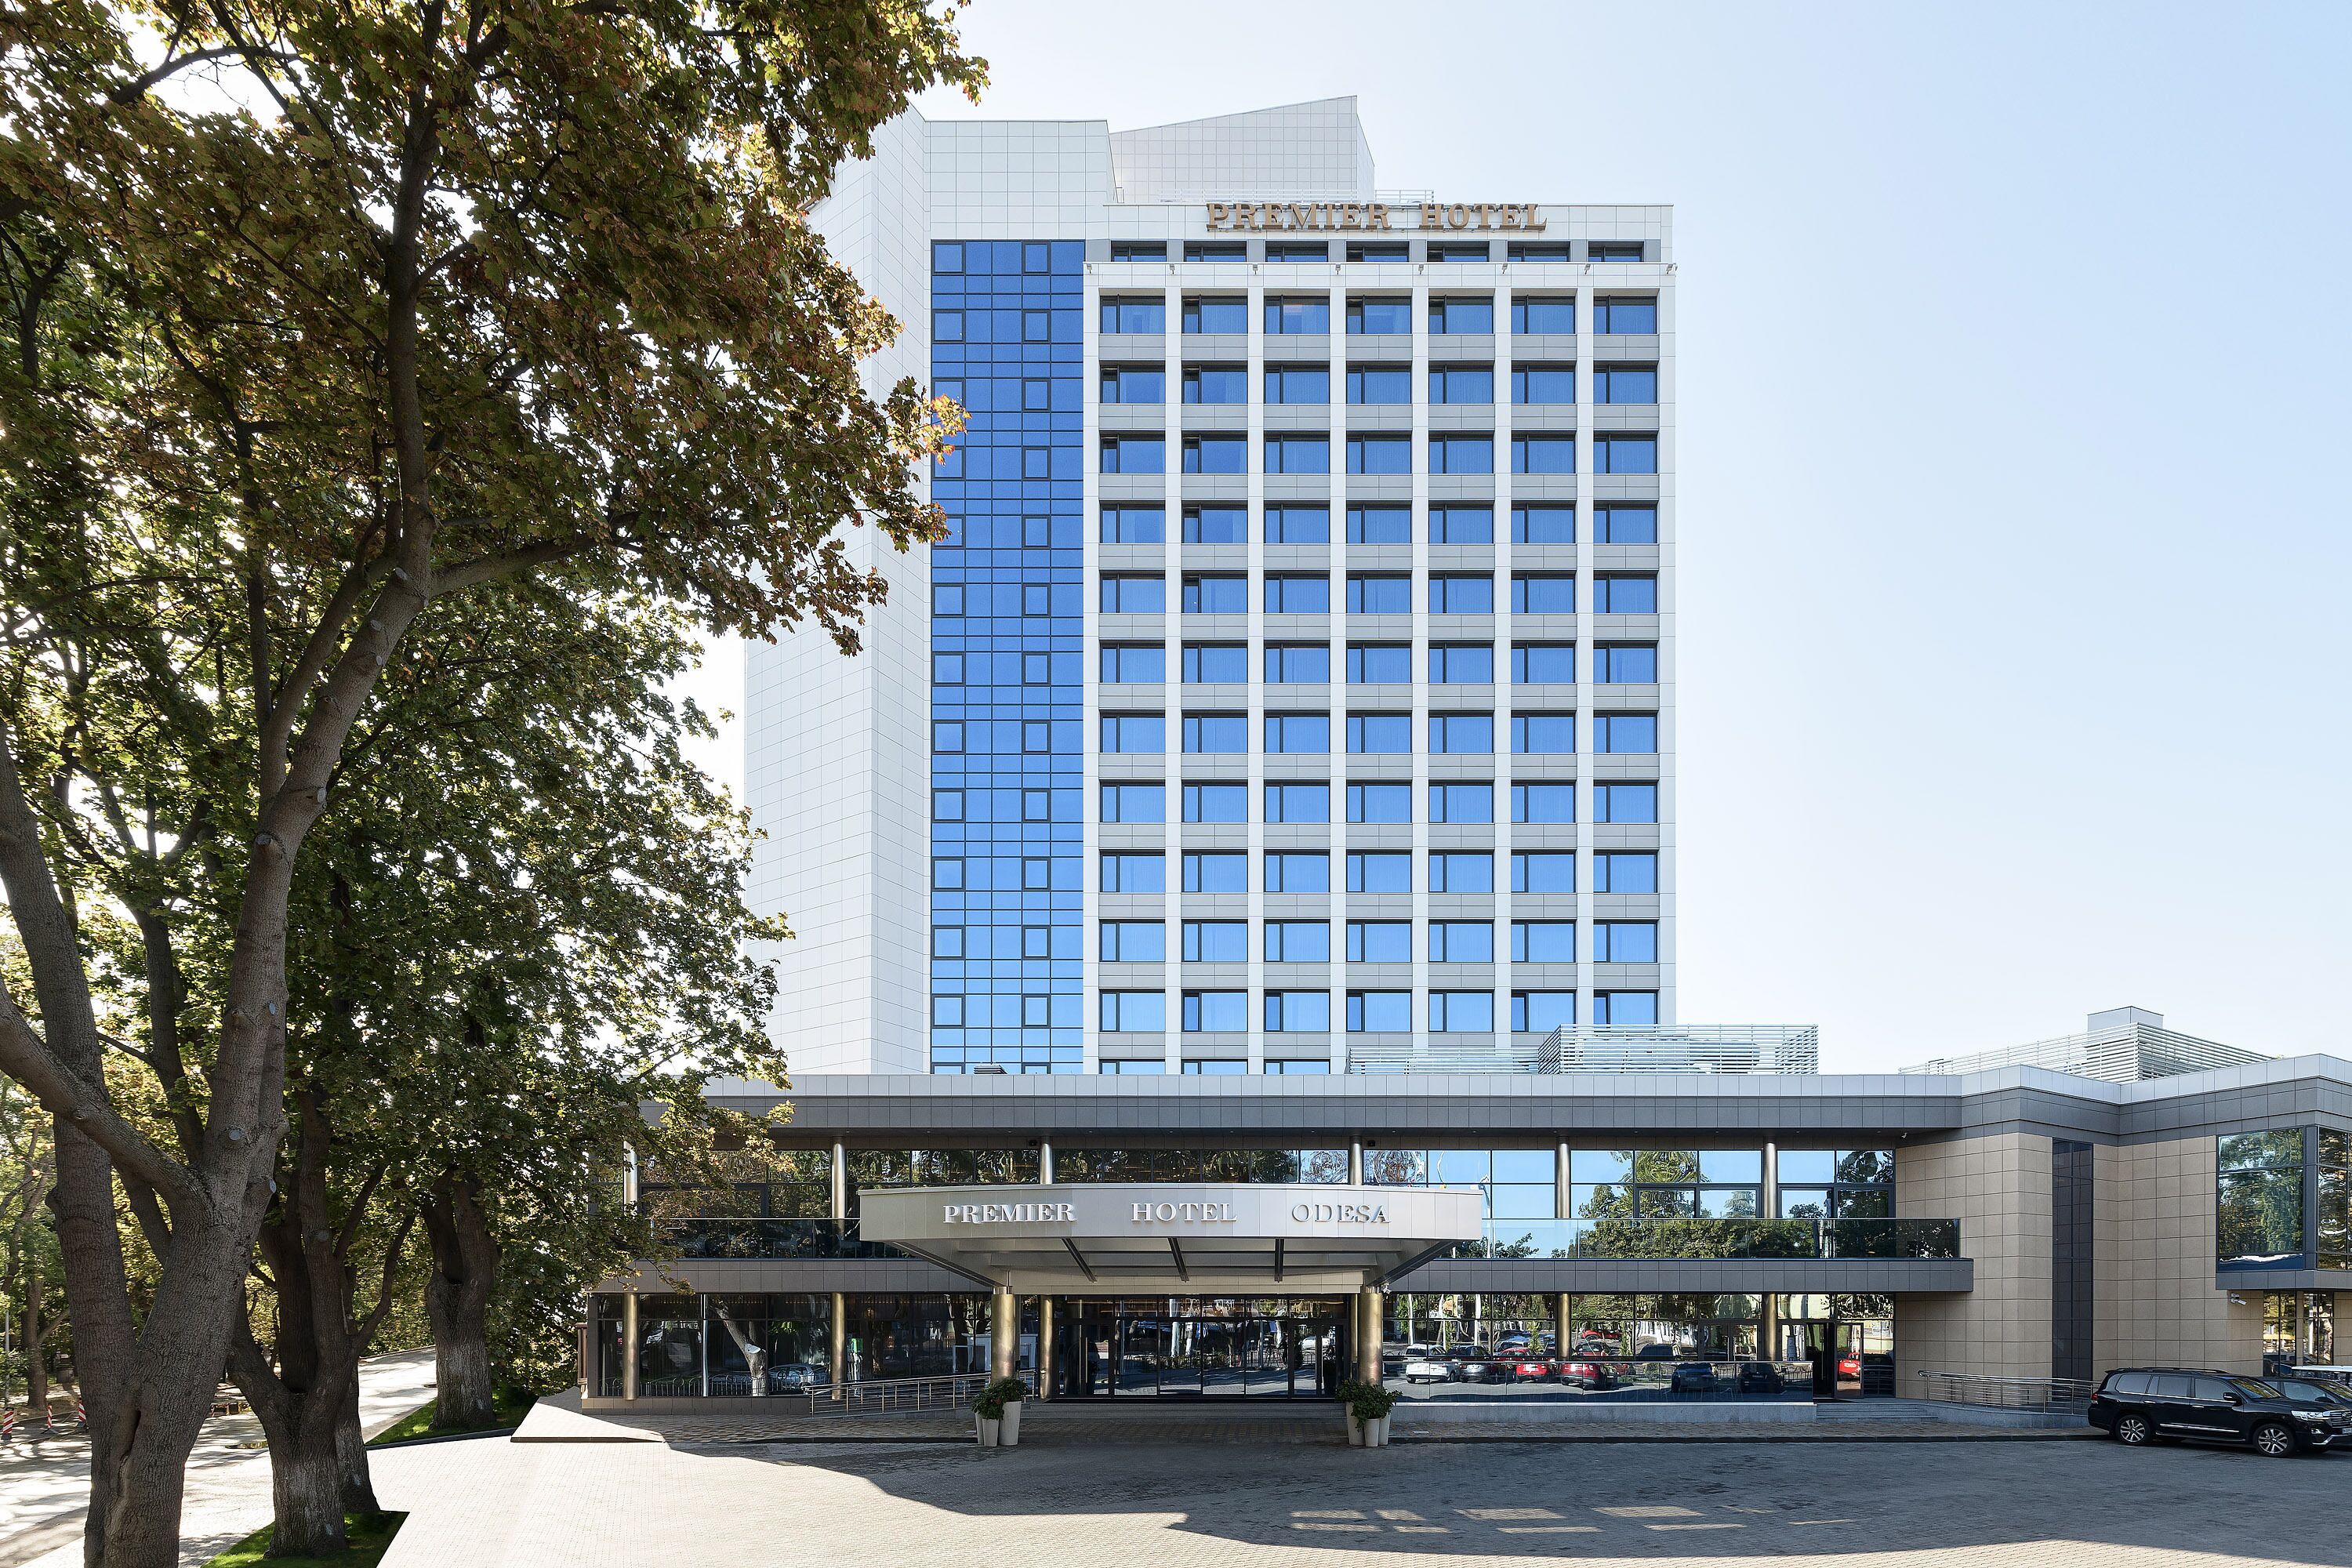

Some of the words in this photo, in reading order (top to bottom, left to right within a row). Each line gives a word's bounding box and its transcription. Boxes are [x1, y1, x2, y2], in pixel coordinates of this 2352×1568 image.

[1207, 203, 1392, 230] PREMIER
[1418, 203, 1547, 230] HOTEL
[942, 1203, 1077, 1224] PREMIER
[1131, 1203, 1237, 1222] HOTEL
[1291, 1204, 1392, 1223] ODESA
